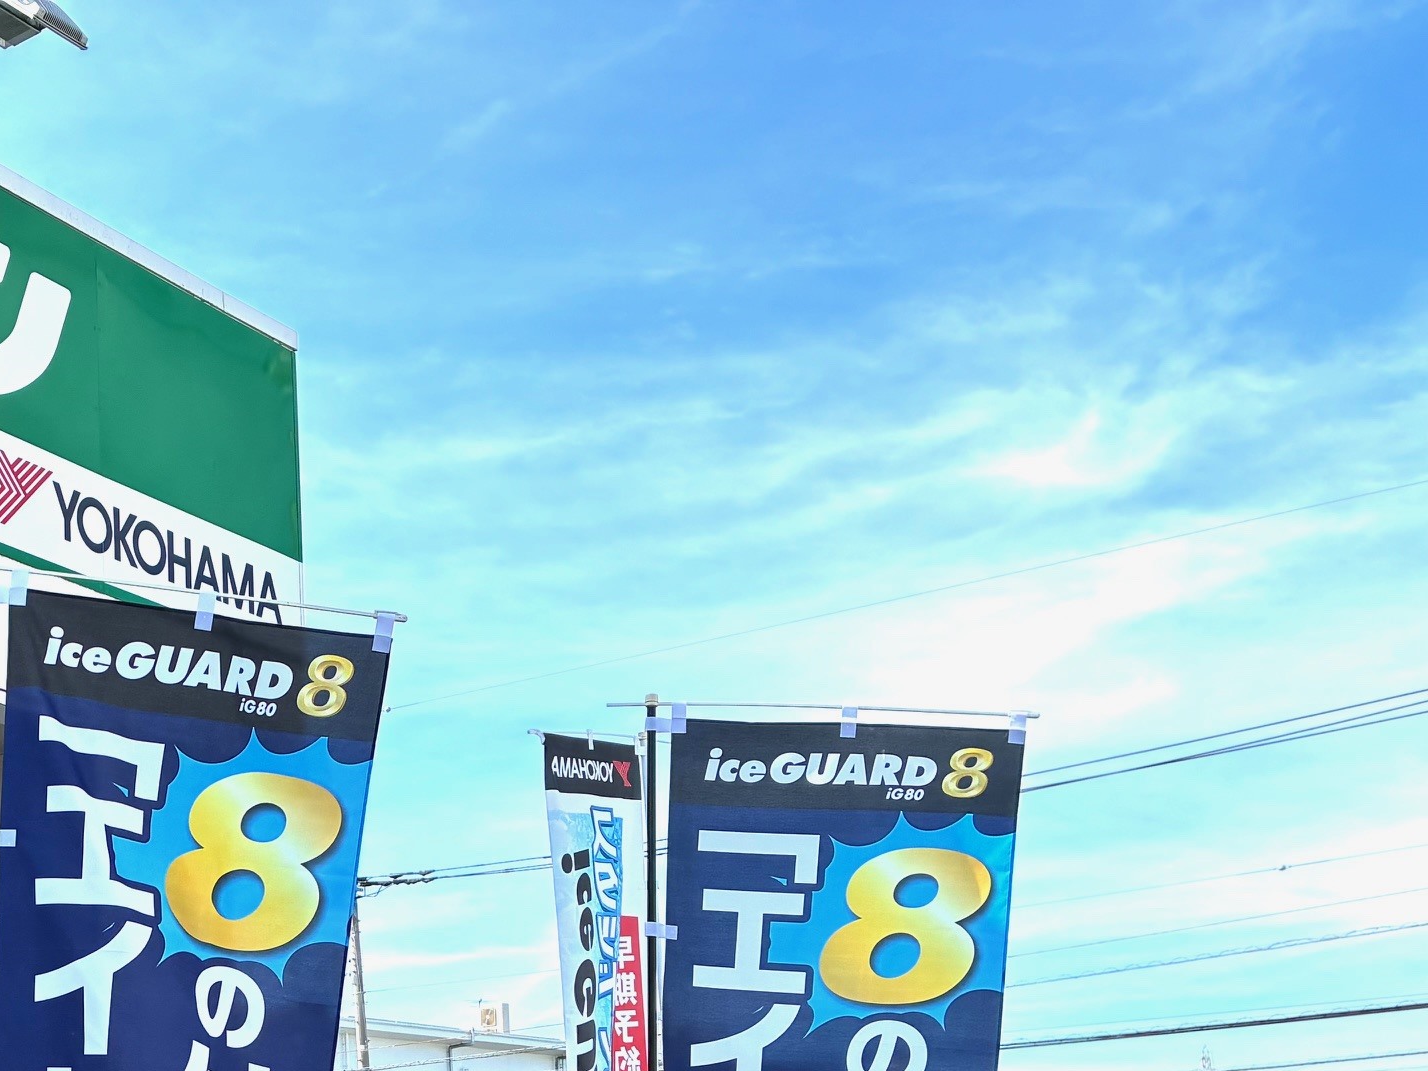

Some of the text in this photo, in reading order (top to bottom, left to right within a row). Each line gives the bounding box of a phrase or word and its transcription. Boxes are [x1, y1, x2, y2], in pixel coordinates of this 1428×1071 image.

[51, 480, 283, 625] YOKOHAMA
[43, 626, 294, 700] iceGUARD
[239, 697, 278, 718] iG80
[704, 748, 938, 787] iceGUARD
[885, 787, 925, 802] iG80
